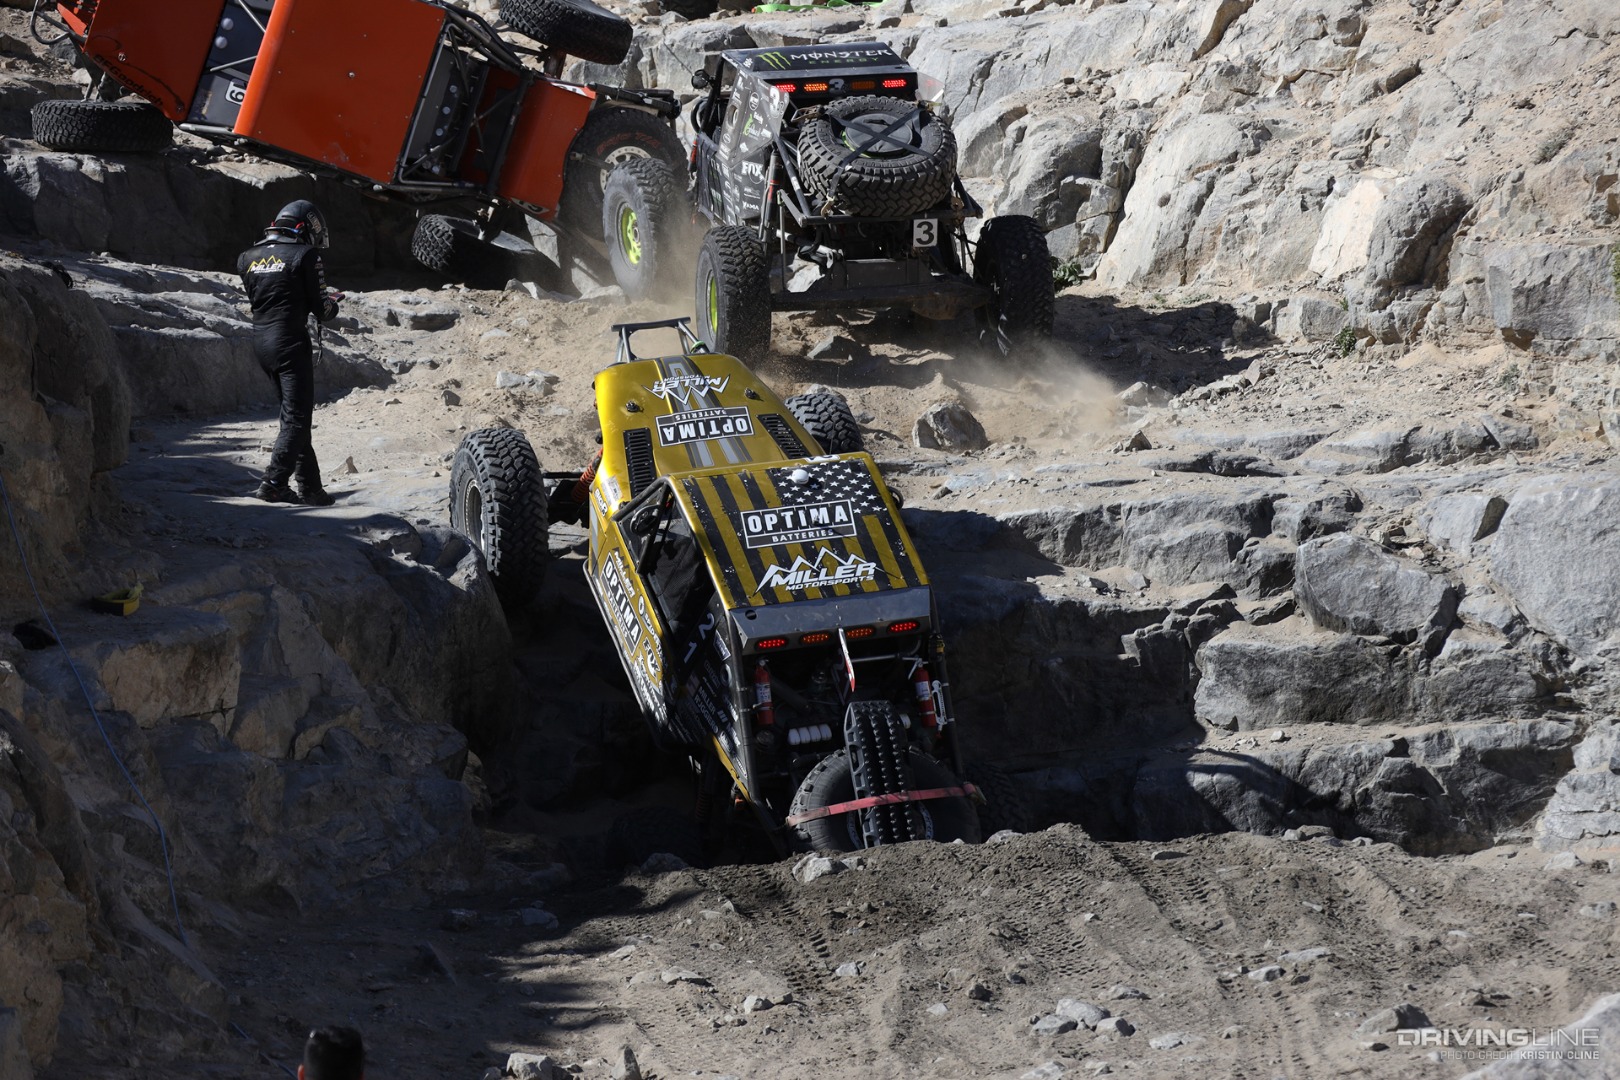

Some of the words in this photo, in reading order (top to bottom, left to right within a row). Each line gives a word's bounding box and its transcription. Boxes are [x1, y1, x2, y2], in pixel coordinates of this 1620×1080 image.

[791, 49, 893, 61] MONSTER
[809, 57, 879, 65] ENERGY
[915, 220, 935, 245] 3
[250, 262, 286, 272] MILLER
[653, 376, 723, 393] MILLER
[674, 409, 728, 421] BATTERIES
[663, 416, 749, 442] OPTIMA
[747, 504, 849, 533] OPTIMA
[772, 529, 834, 543] BATTERIES
[769, 562, 877, 588] MILLER
[785, 574, 875, 591] MOTORSPORTS
[605, 561, 639, 642] OPTIMA
